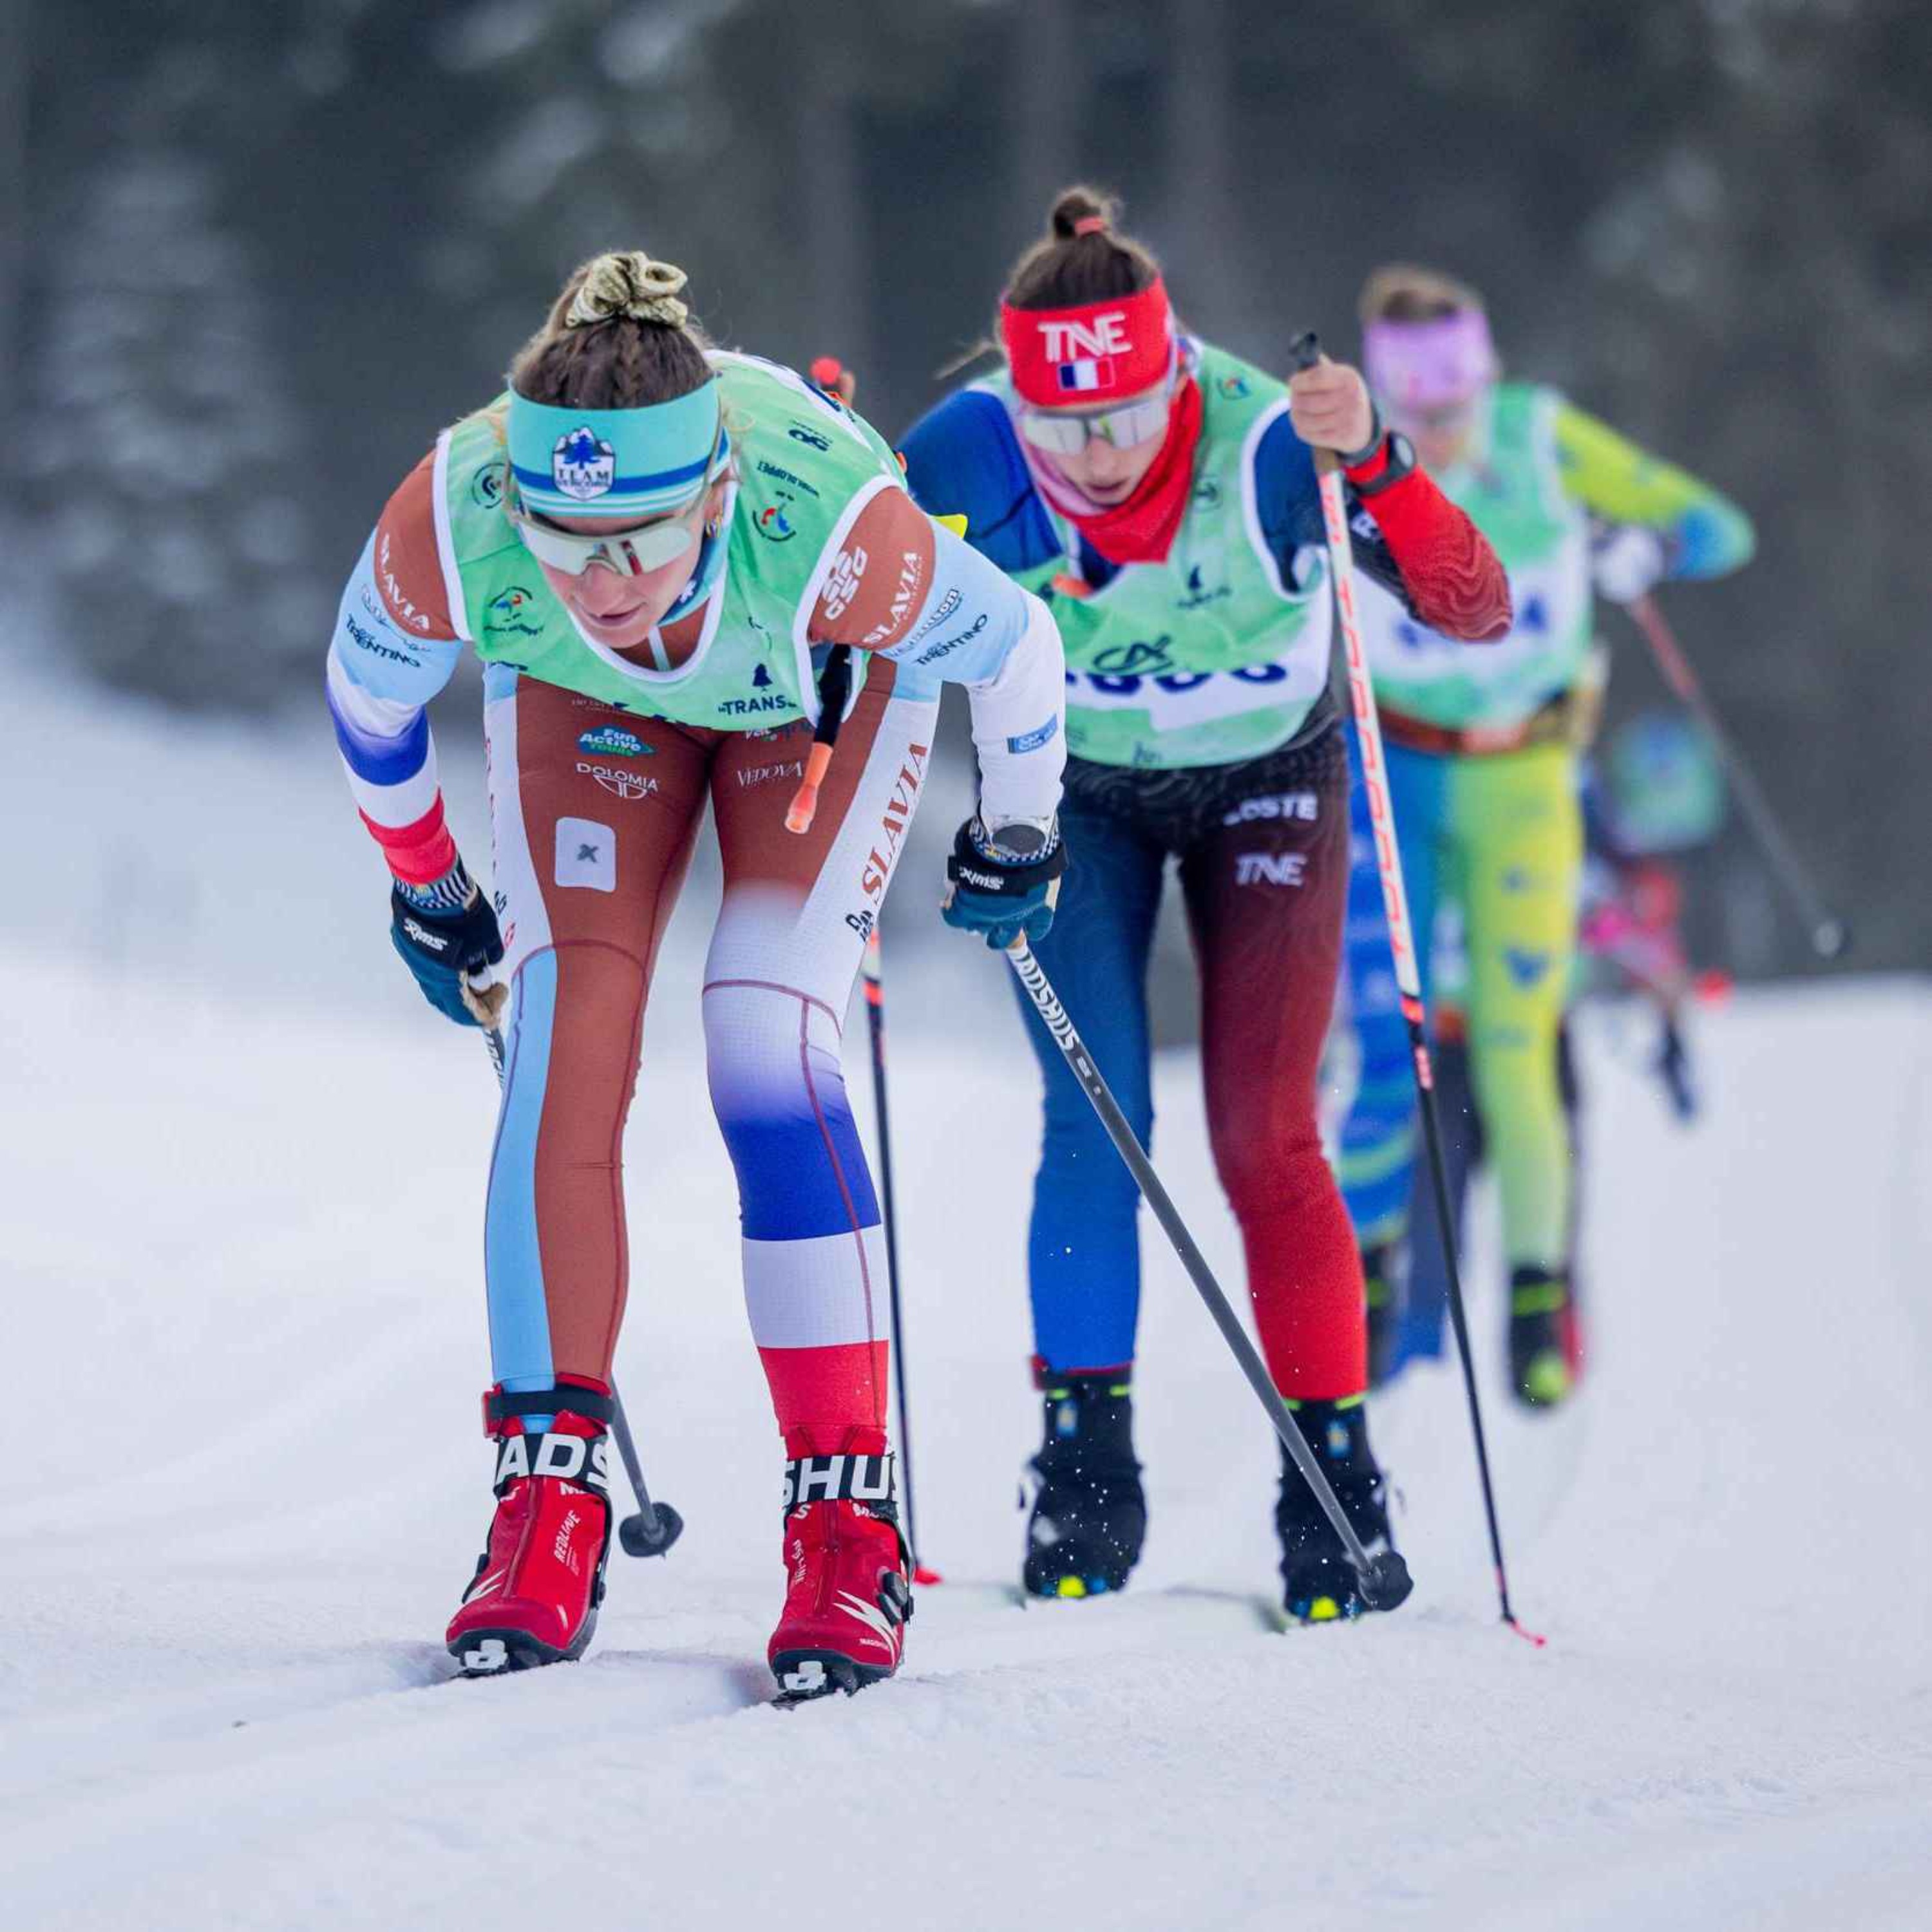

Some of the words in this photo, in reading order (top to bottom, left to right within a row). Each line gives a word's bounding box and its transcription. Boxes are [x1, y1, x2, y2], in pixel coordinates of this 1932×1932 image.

[1037, 311, 1133, 363] TNE
[862, 553, 917, 643] SLAVIA
[580, 733, 641, 752] Active
[603, 728, 638, 743] Fun
[576, 762, 658, 792] DOLOMIA
[862, 743, 927, 904] SLAVIA
[1236, 853, 1308, 886] TNE
[554, 1510, 581, 1563] REDLINE
